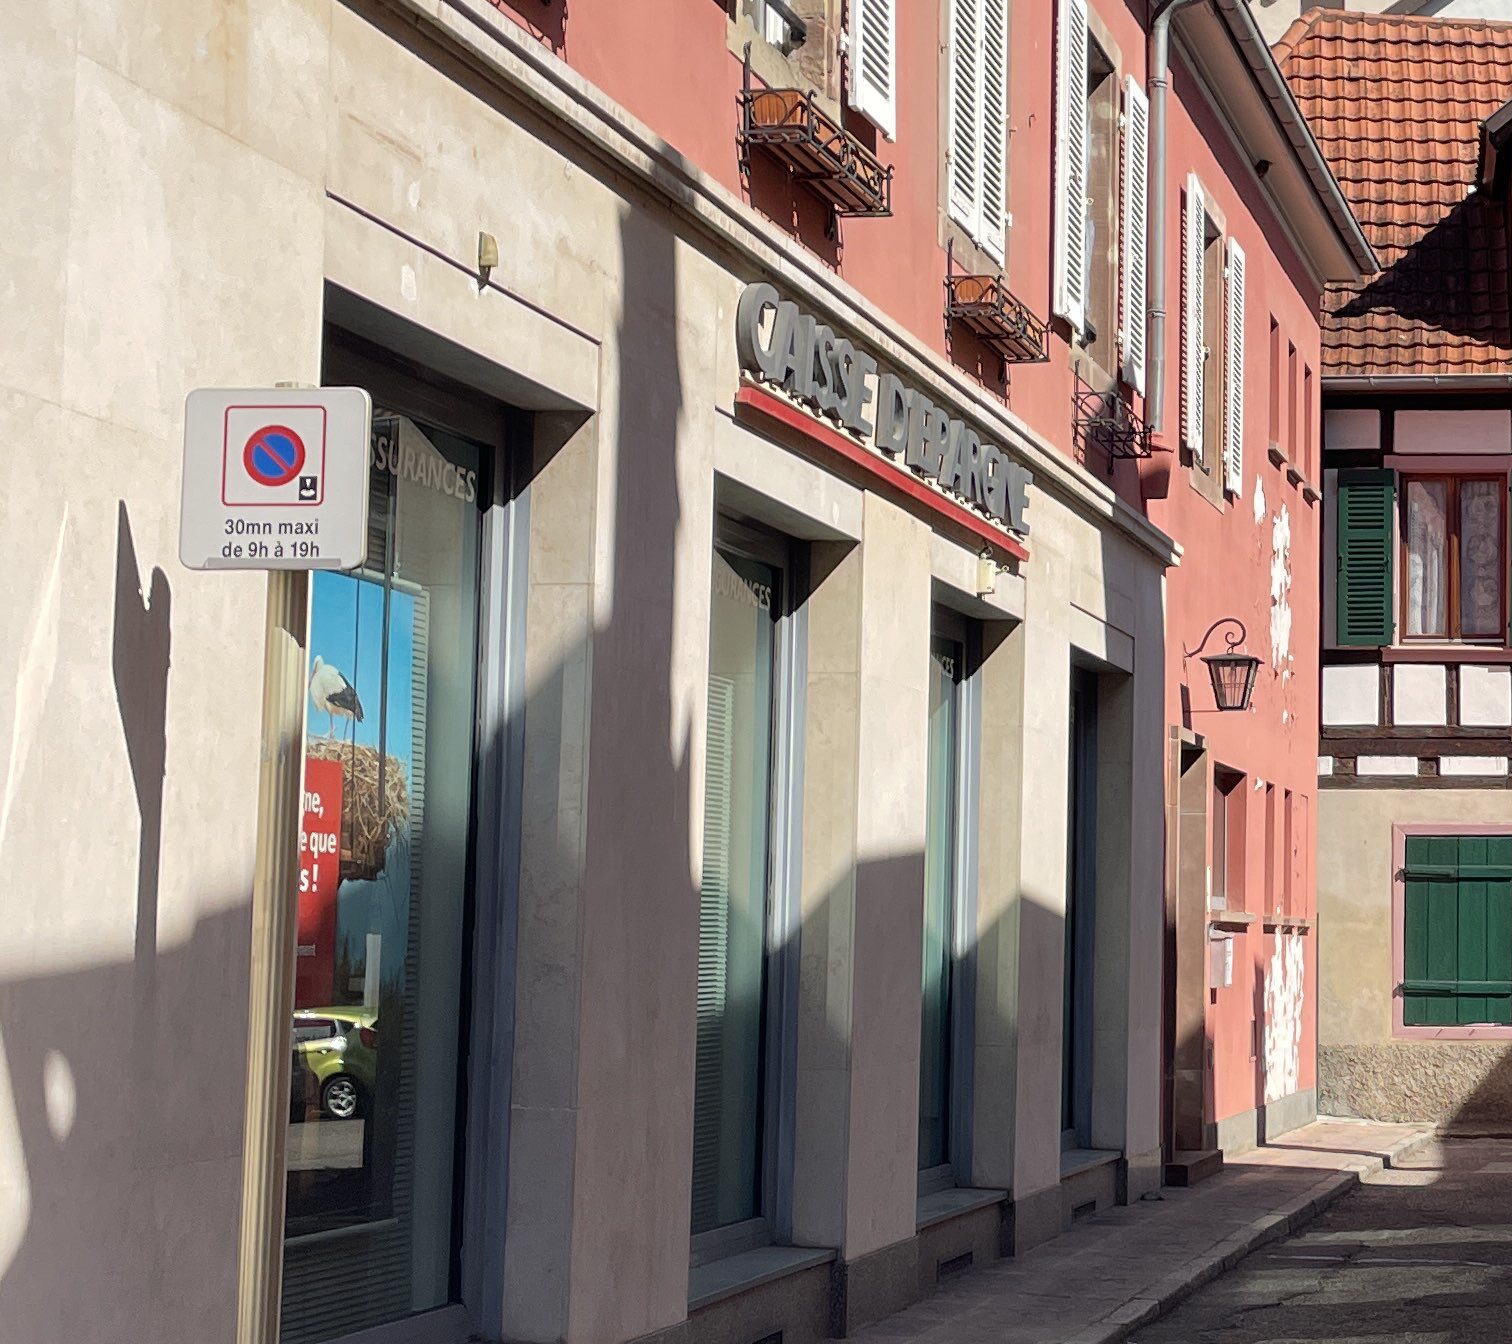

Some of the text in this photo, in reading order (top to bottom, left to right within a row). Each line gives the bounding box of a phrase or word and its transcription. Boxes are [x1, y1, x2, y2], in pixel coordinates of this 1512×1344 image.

[736, 282, 879, 439] CAISSE
[224, 518, 319, 535] 30mn maxi
[222, 541, 320, 558] de 9h à 19h
[310, 831, 337, 859] que
